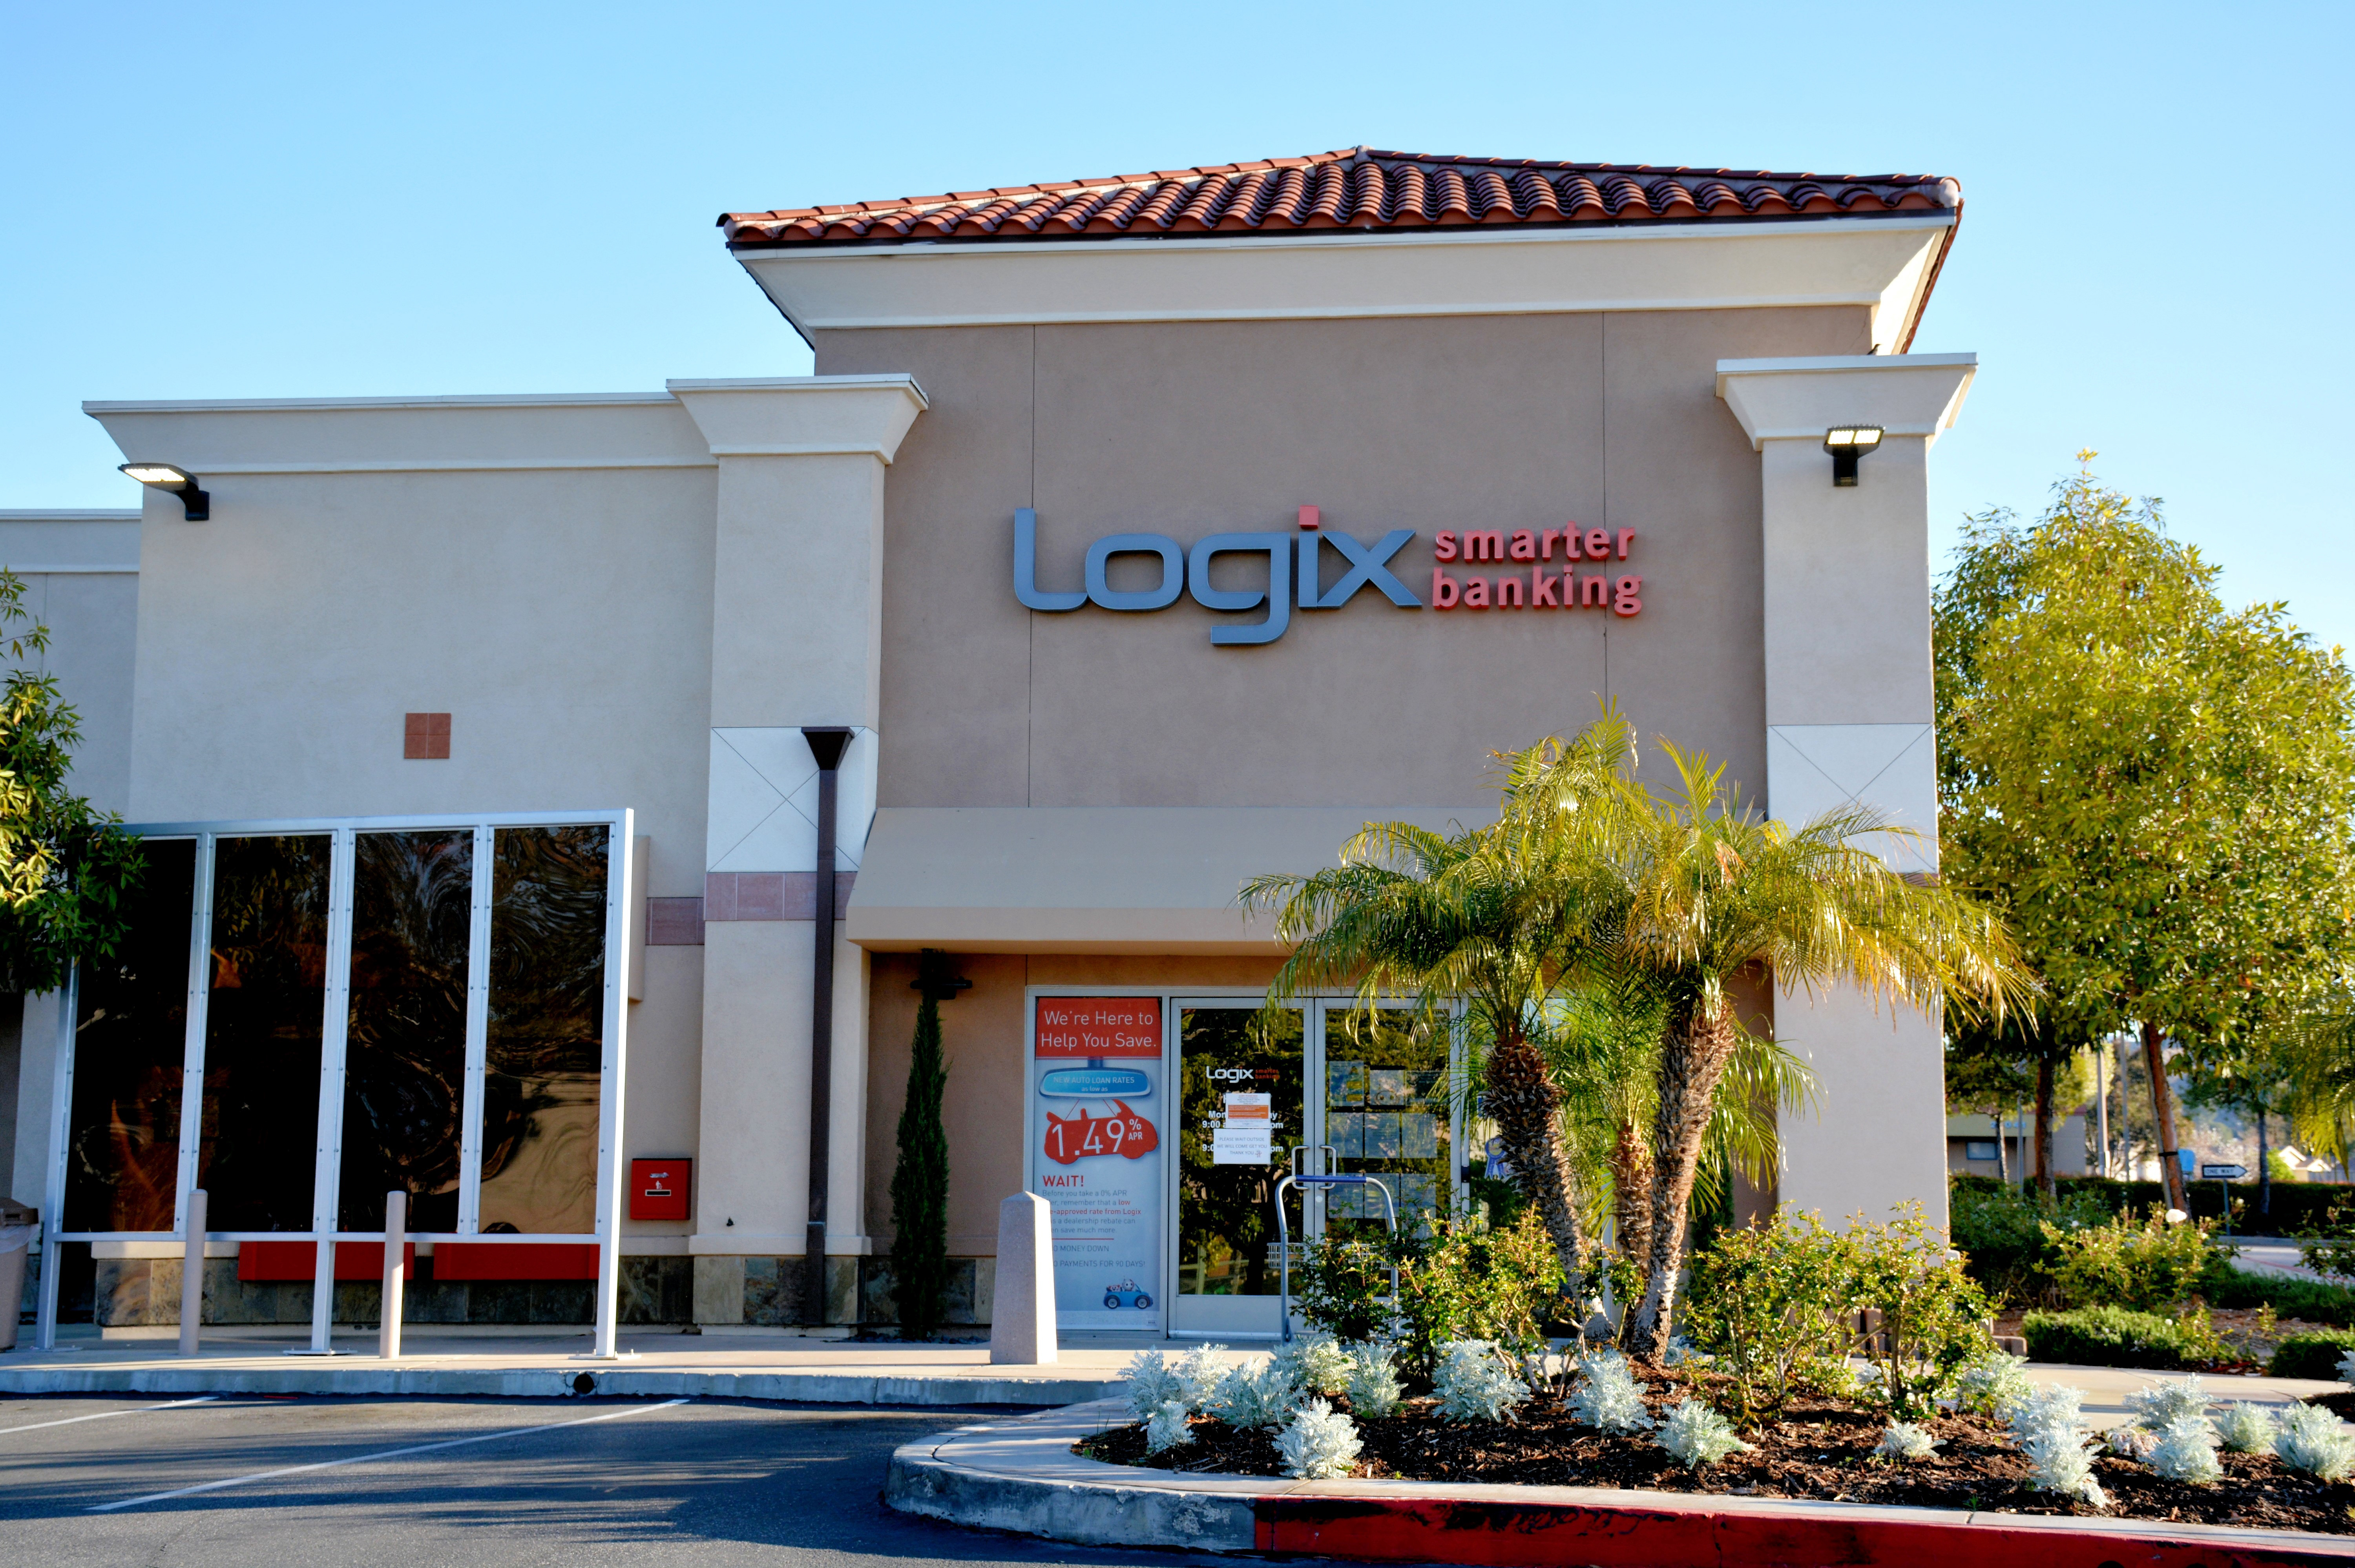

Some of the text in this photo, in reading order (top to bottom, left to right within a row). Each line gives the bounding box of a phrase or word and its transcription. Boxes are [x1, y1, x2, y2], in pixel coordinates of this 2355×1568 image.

[1435, 520, 1636, 562] smarter
[1014, 505, 1422, 646] Logix
[1432, 565, 1642, 618] banking
[1044, 1011, 1153, 1025] We're Here to
[1041, 1033, 1157, 1051] Help You Save.
[1206, 1066, 1254, 1083] Logix
[1202, 1120, 1221, 1129] 9:00
[1128, 1132, 1143, 1141] APR
[1042, 1175, 1084, 1187] WAIT!
